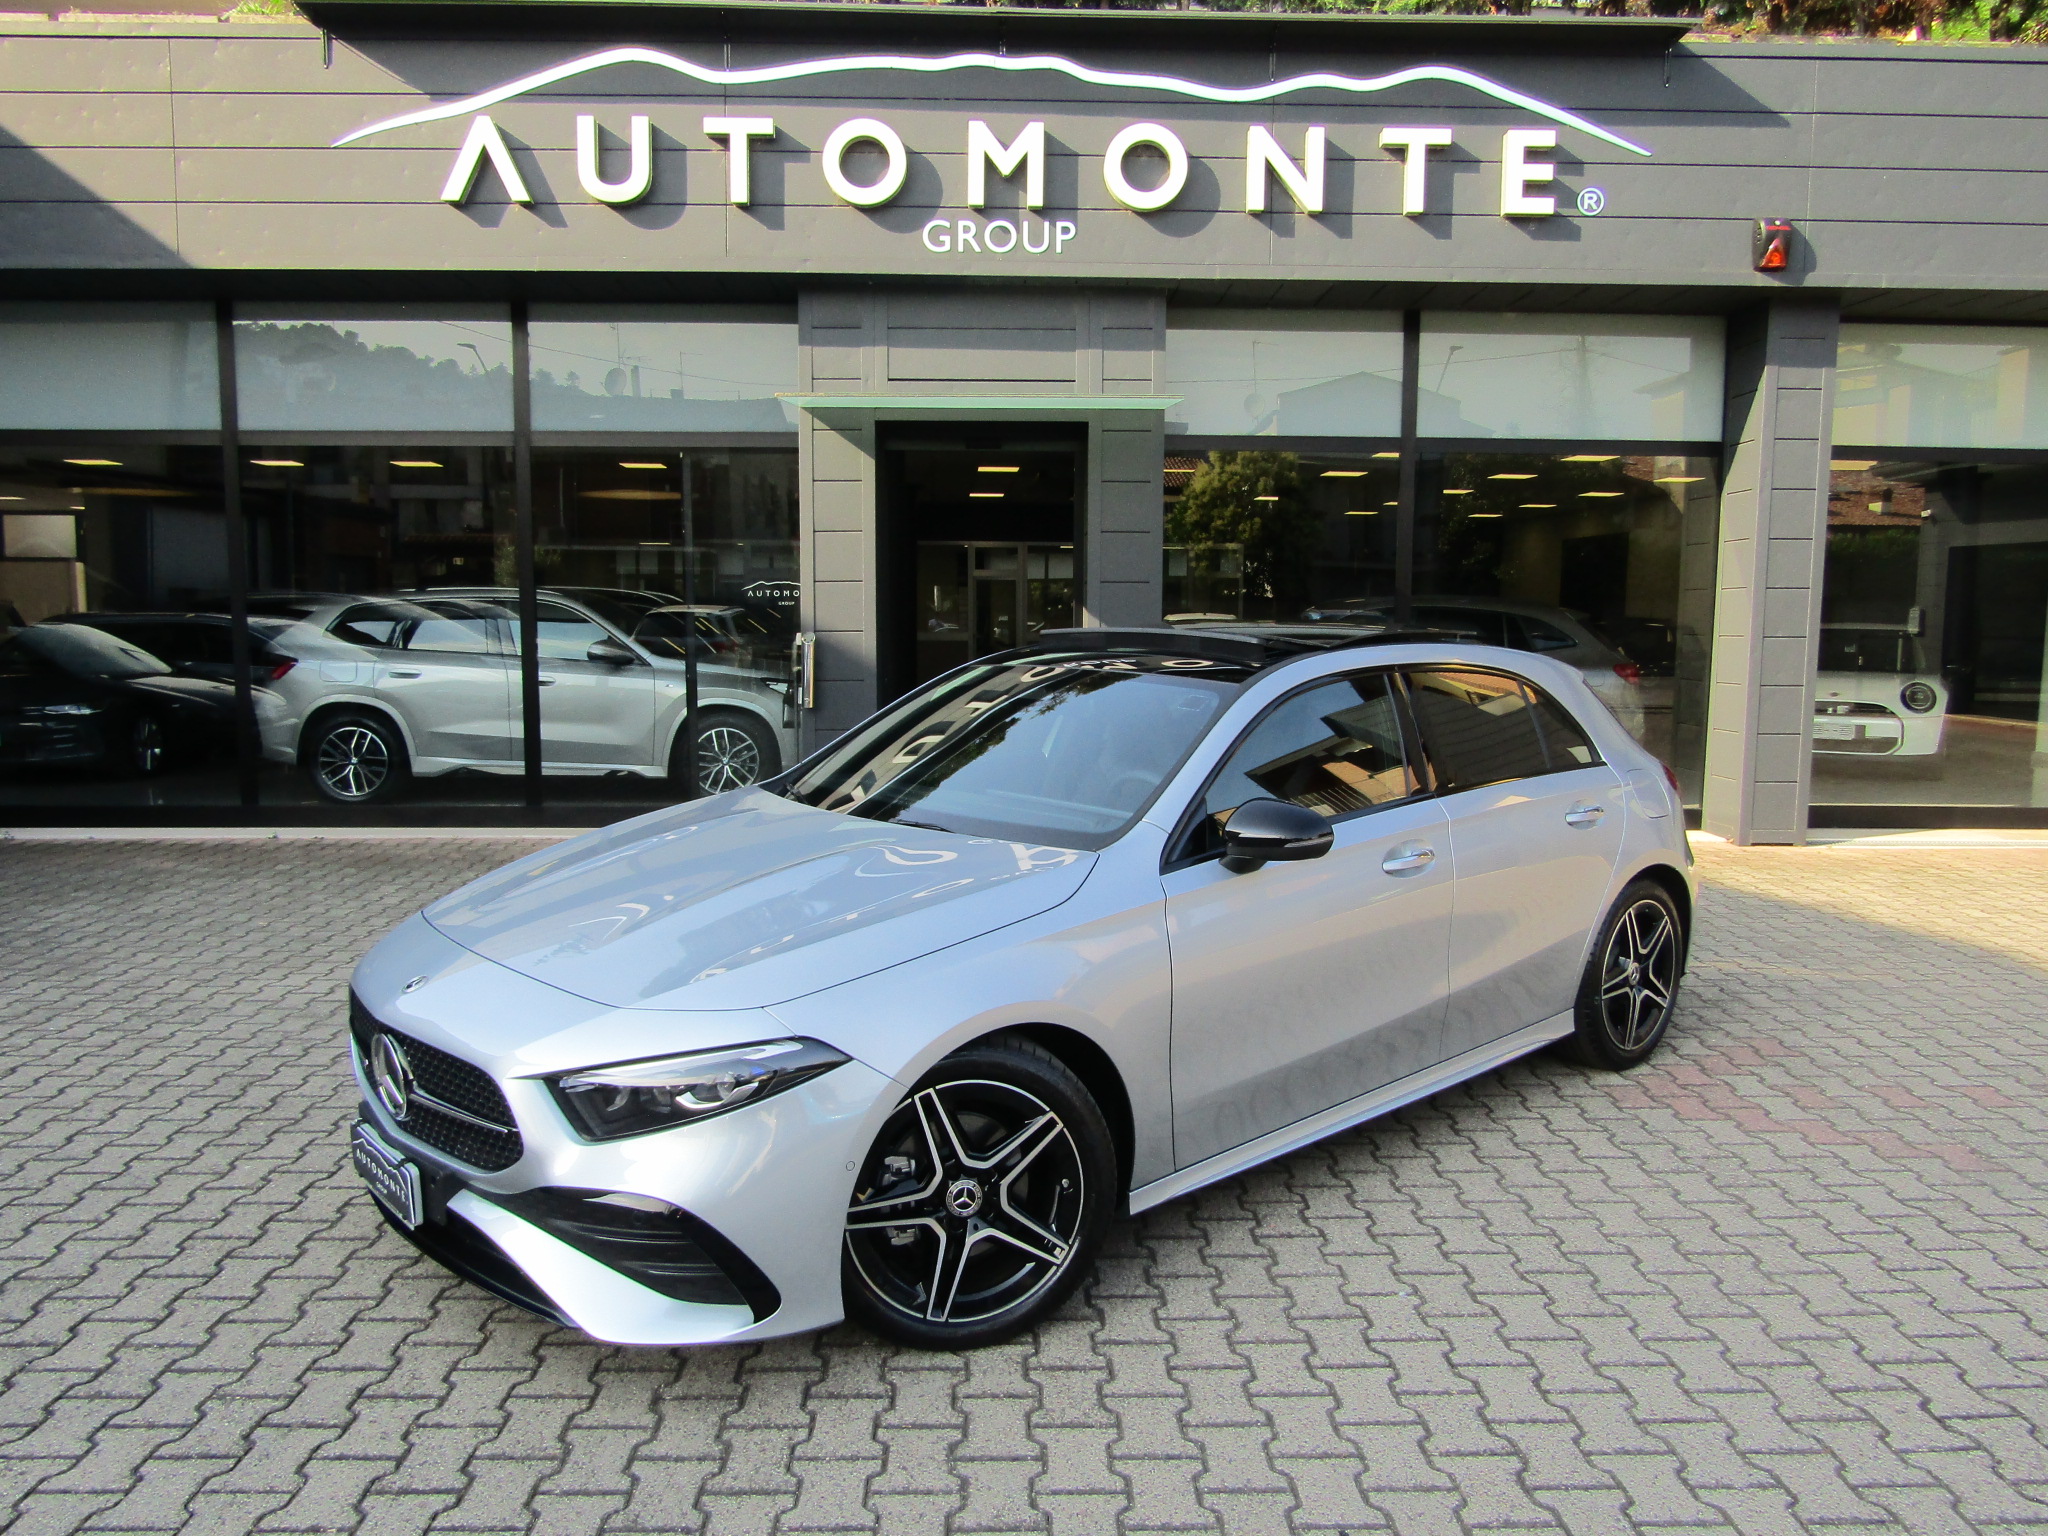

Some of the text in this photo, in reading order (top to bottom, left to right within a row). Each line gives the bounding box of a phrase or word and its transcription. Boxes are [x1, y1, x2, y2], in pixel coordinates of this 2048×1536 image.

[440, 114, 1557, 218] AUTOMONTE
[922, 219, 1077, 254] GROUP
[356, 1148, 406, 1202] AUTOMONTE
